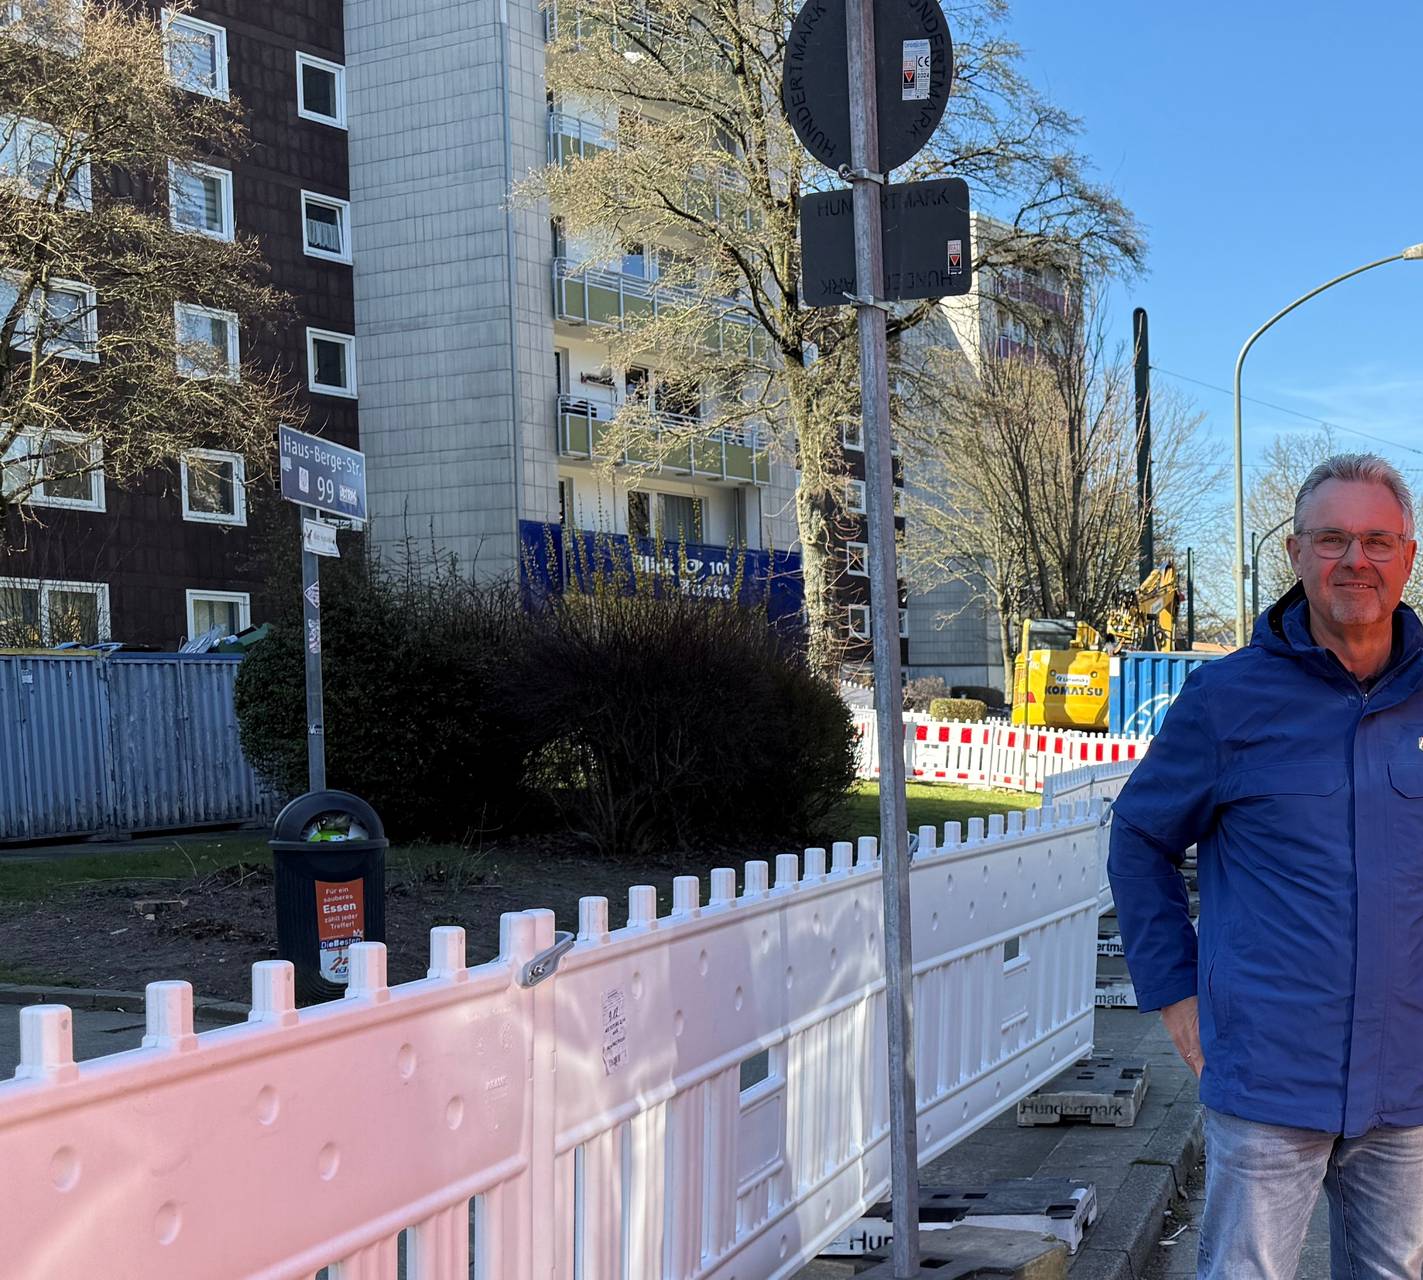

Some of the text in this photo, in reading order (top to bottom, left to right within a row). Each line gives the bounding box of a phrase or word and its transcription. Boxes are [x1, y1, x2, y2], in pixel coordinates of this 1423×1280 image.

[905, 0, 946, 137] UNDERTMARK
[817, 187, 950, 217] HUNRTMARK
[283, 434, 362, 478] Haus-Berge-Str.
[317, 476, 334, 503] 99
[709, 561, 730, 576] 101
[1045, 685, 1104, 697] KOMATSU
[322, 902, 357, 914] Essen
